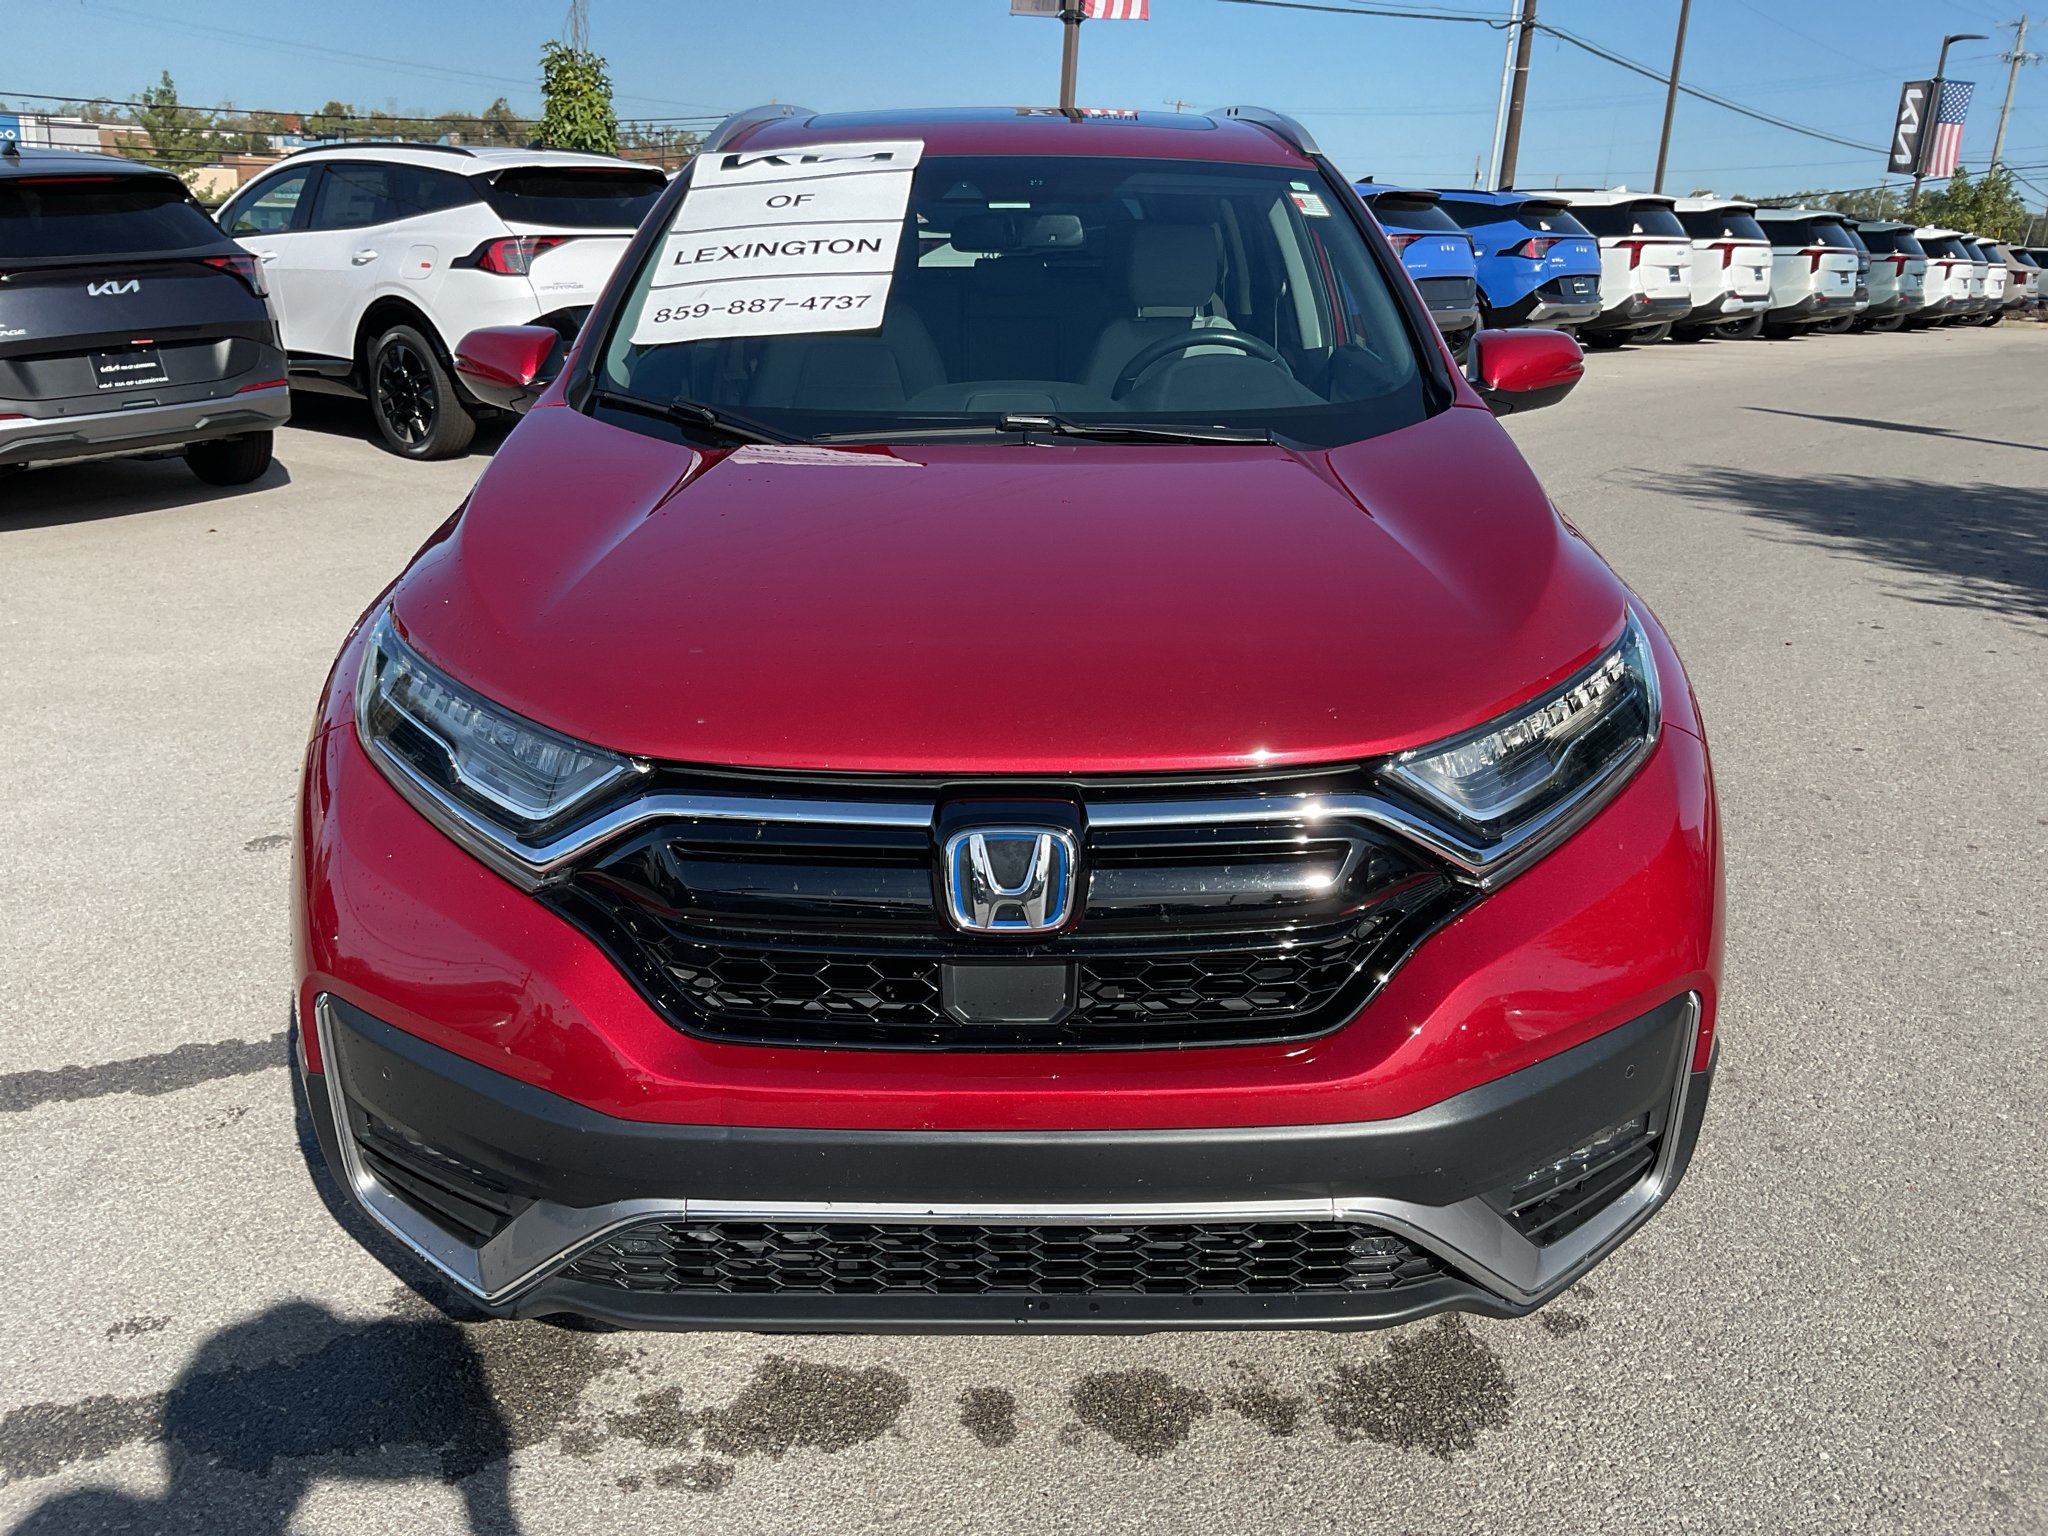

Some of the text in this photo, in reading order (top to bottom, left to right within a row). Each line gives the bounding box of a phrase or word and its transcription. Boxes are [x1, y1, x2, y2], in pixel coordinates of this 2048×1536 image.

[765, 193, 815, 208] OF
[673, 238, 882, 266] LEXINGTON
[87, 279, 140, 296] KIA
[653, 294, 872, 323] 859-887-4737
